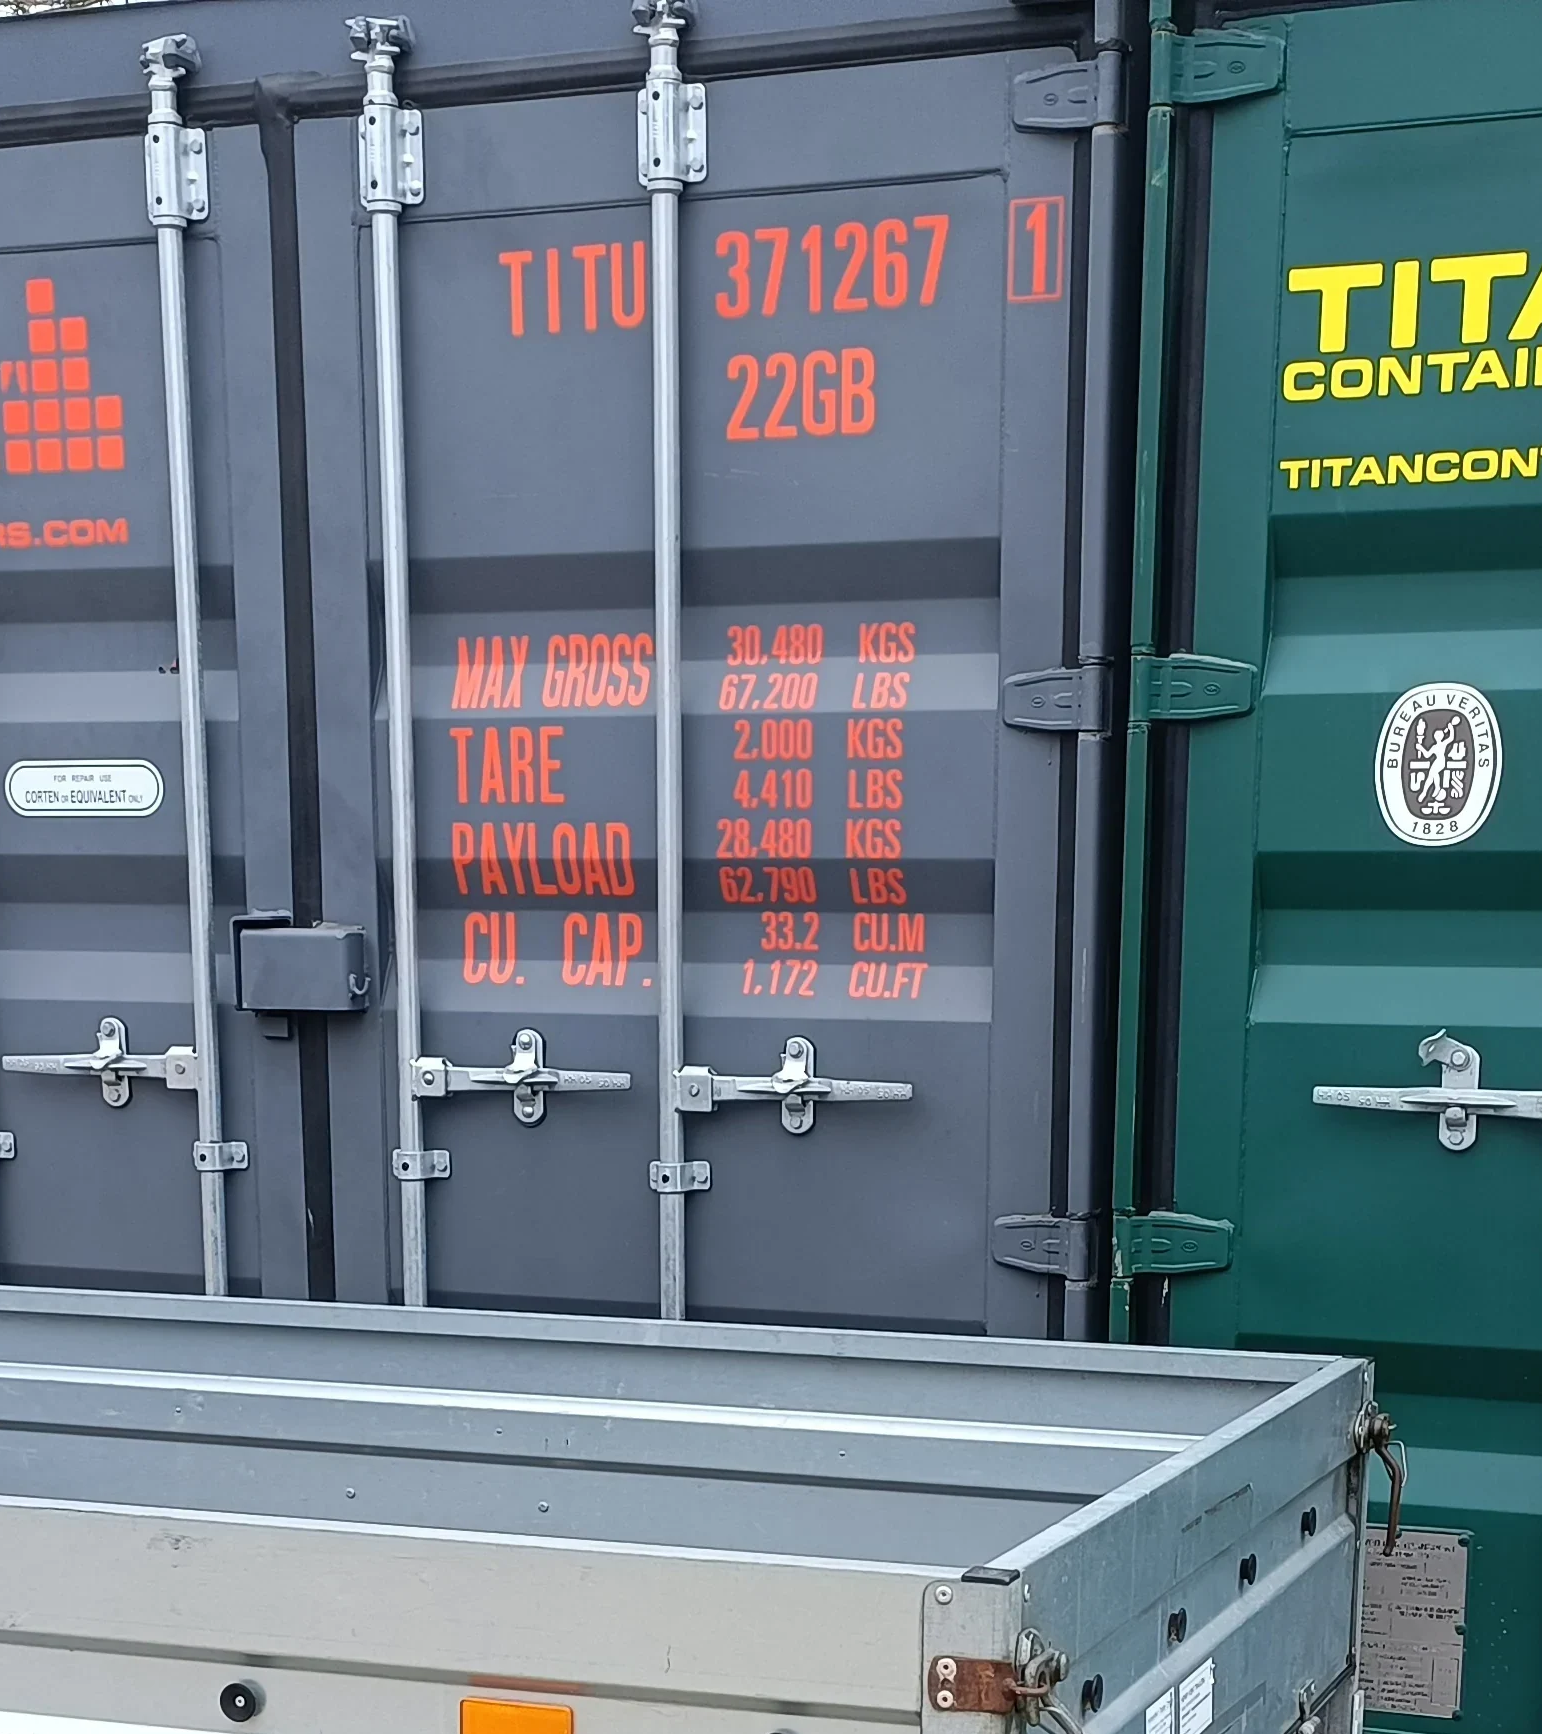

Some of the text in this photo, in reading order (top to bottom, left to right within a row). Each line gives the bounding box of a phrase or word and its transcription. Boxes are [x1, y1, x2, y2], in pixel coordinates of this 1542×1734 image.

[499, 204, 1050, 337] TITU 371267 1
[726, 347, 877, 442] 22GB
[451, 636, 530, 710] MAX
[542, 633, 655, 709] GROSS
[859, 622, 916, 665] KGS
[852, 672, 911, 710] LBS
[449, 726, 566, 806] TARE
[847, 718, 904, 761] KGS
[1387, 694, 1491, 769] BUREAU VERITAS
[25, 790, 60, 804] CORTEN
[70, 789, 127, 804] EQUIVALENT
[848, 769, 904, 812] LBS
[1412, 820, 1459, 835] 1828
[452, 822, 636, 898] PAYLOAD
[846, 819, 902, 862] KGS
[850, 868, 907, 907] LBS
[463, 911, 925, 988] CU. CAP. 33.2 CU.M
[849, 961, 928, 999] CU.FT
